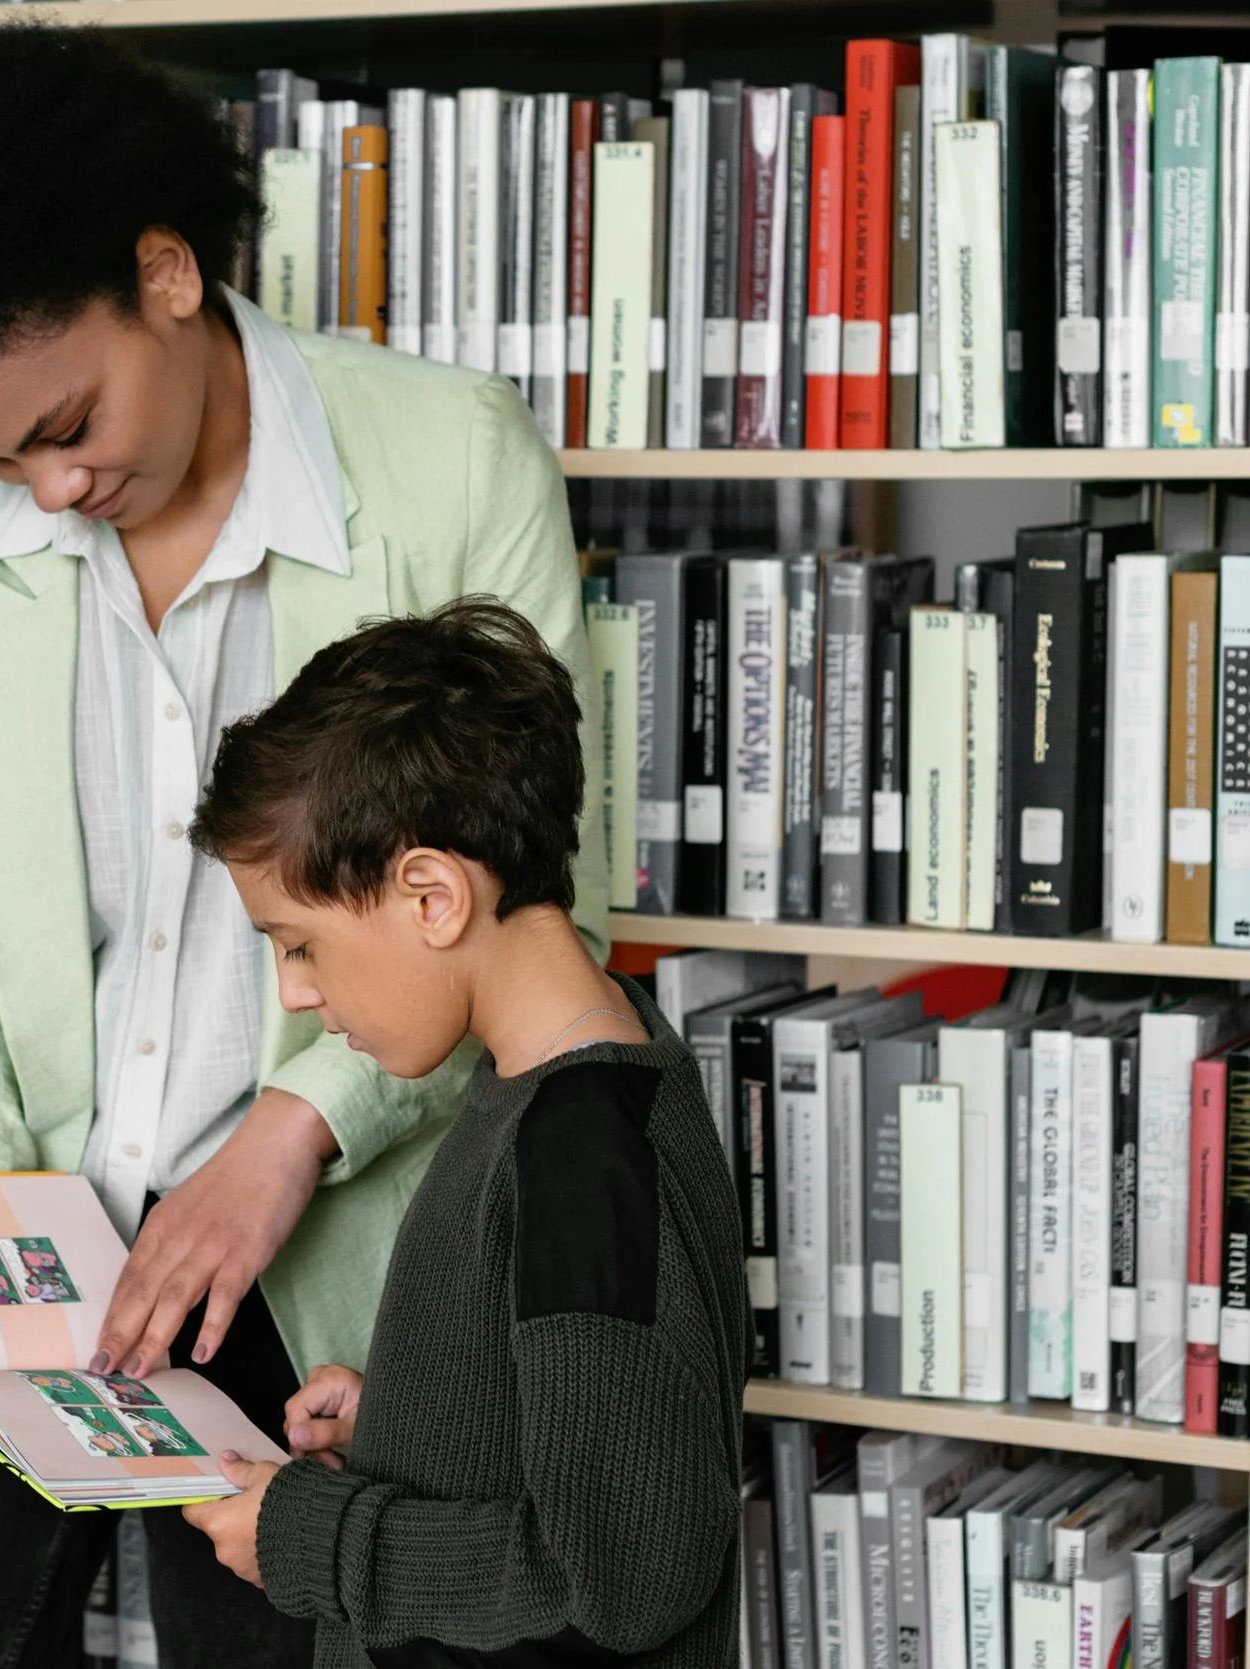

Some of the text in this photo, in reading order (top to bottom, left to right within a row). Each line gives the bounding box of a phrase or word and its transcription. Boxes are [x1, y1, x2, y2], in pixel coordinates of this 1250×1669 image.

[854, 107, 871, 268] Theories of the LABOR
[951, 125, 977, 140] 332
[1175, 166, 1191, 271] CORPORATE
[1190, 167, 1207, 263] FINANCIAL
[605, 298, 625, 445] Working women
[955, 246, 975, 443] Financial economics
[738, 608, 771, 747] THE OPTIONS
[925, 616, 951, 629] 333
[1034, 613, 1053, 763] Ecological Economics
[925, 769, 940, 921] Land economics
[1042, 1086, 1058, 1198] THE GLOBAL
[918, 1289, 936, 1393] Production
